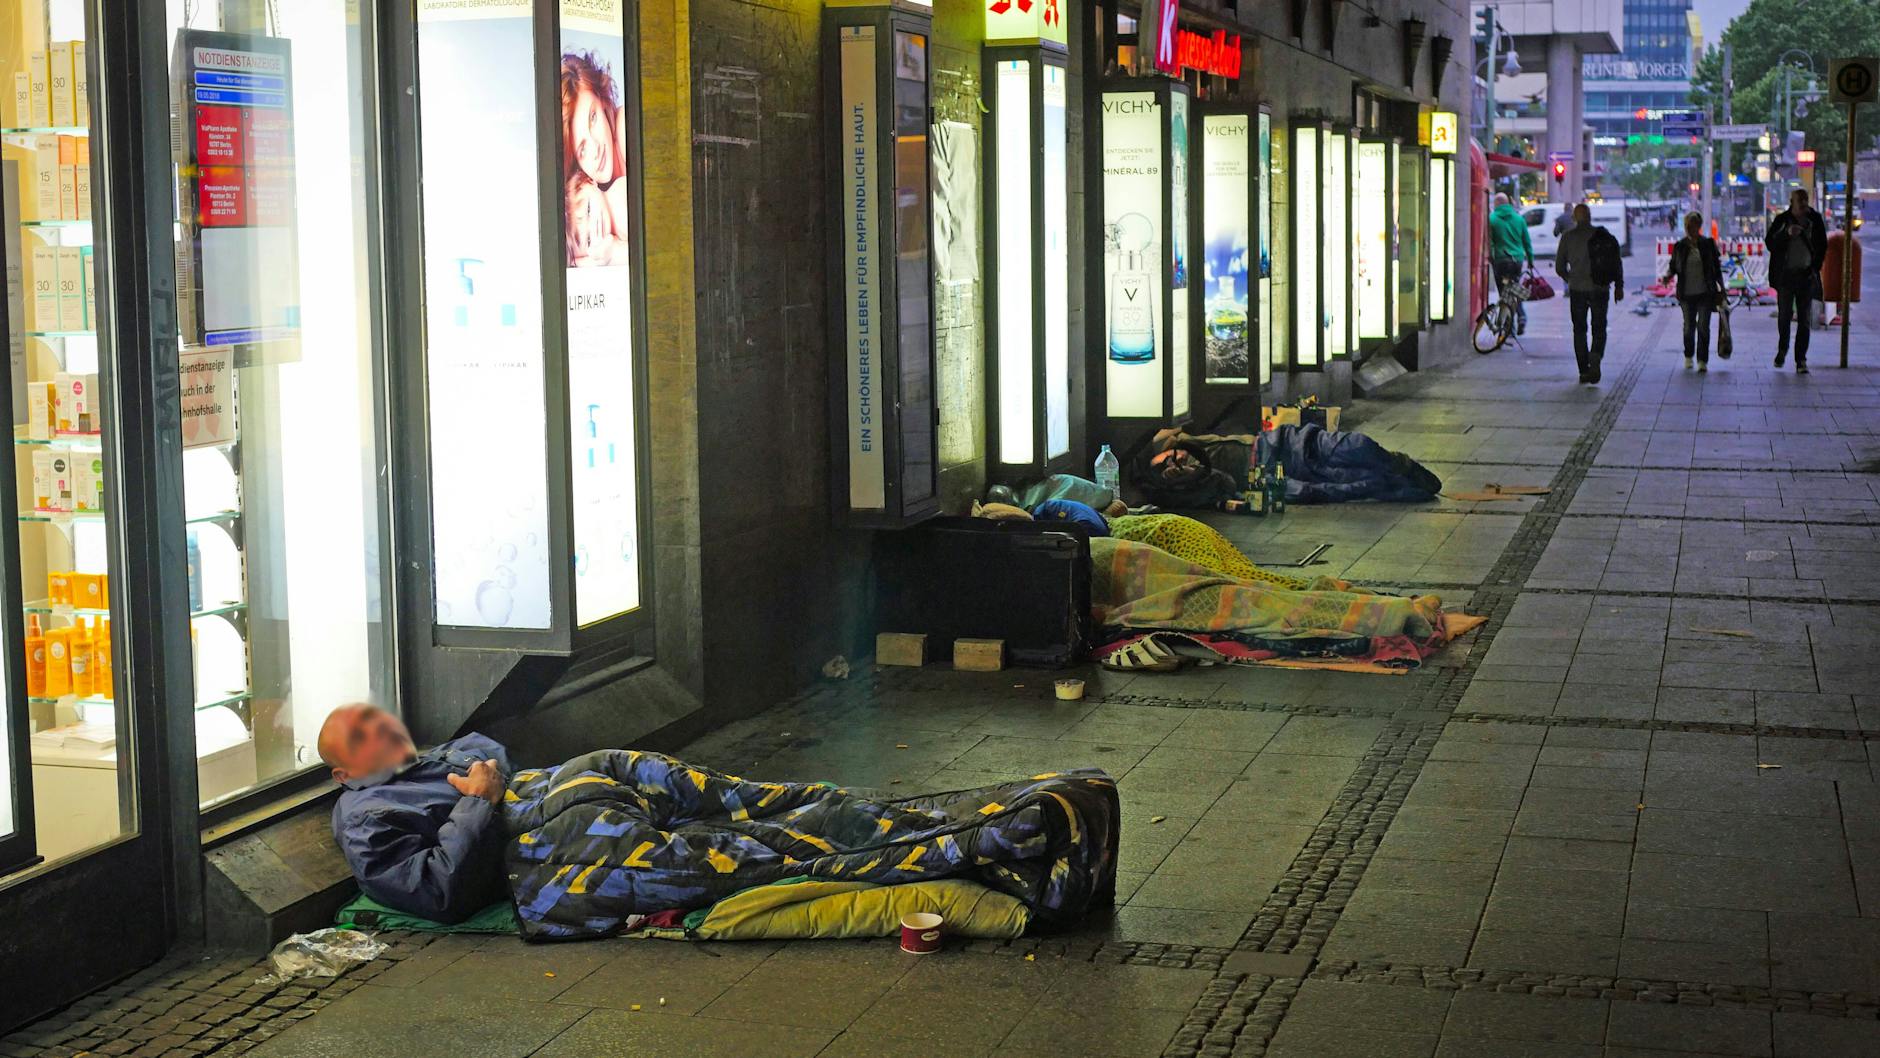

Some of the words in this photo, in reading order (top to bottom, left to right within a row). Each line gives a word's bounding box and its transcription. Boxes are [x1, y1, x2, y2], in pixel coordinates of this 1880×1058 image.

[423, 1, 467, 10] LABORATOIRE
[199, 52, 281, 70] NOTDIENSTANZEIGE
[53, 77, 66, 89] 30
[1846, 70, 1862, 89] H
[32, 82, 44, 92] 30
[17, 91, 27, 101] 30
[1102, 100, 1155, 114] VICHY
[853, 101, 865, 143] HAUT.
[1206, 125, 1247, 136] VICHY
[40, 171, 50, 182] 15
[1146, 167, 1158, 175] 89
[62, 184, 72, 193] 25
[78, 183, 88, 192] 25
[854, 147, 867, 253] EMPFINDLICHE
[855, 256, 867, 285] FÜR
[36, 280, 50, 291] 30
[60, 280, 74, 291] 30
[1124, 287, 1138, 302] V
[568, 293, 606, 312] LIPIKAR
[857, 289, 869, 335] LEBEN
[858, 337, 871, 425] SCHÖNERES
[196, 384, 204, 396] in
[204, 383, 216, 395] der
[860, 428, 872, 452] EIN
